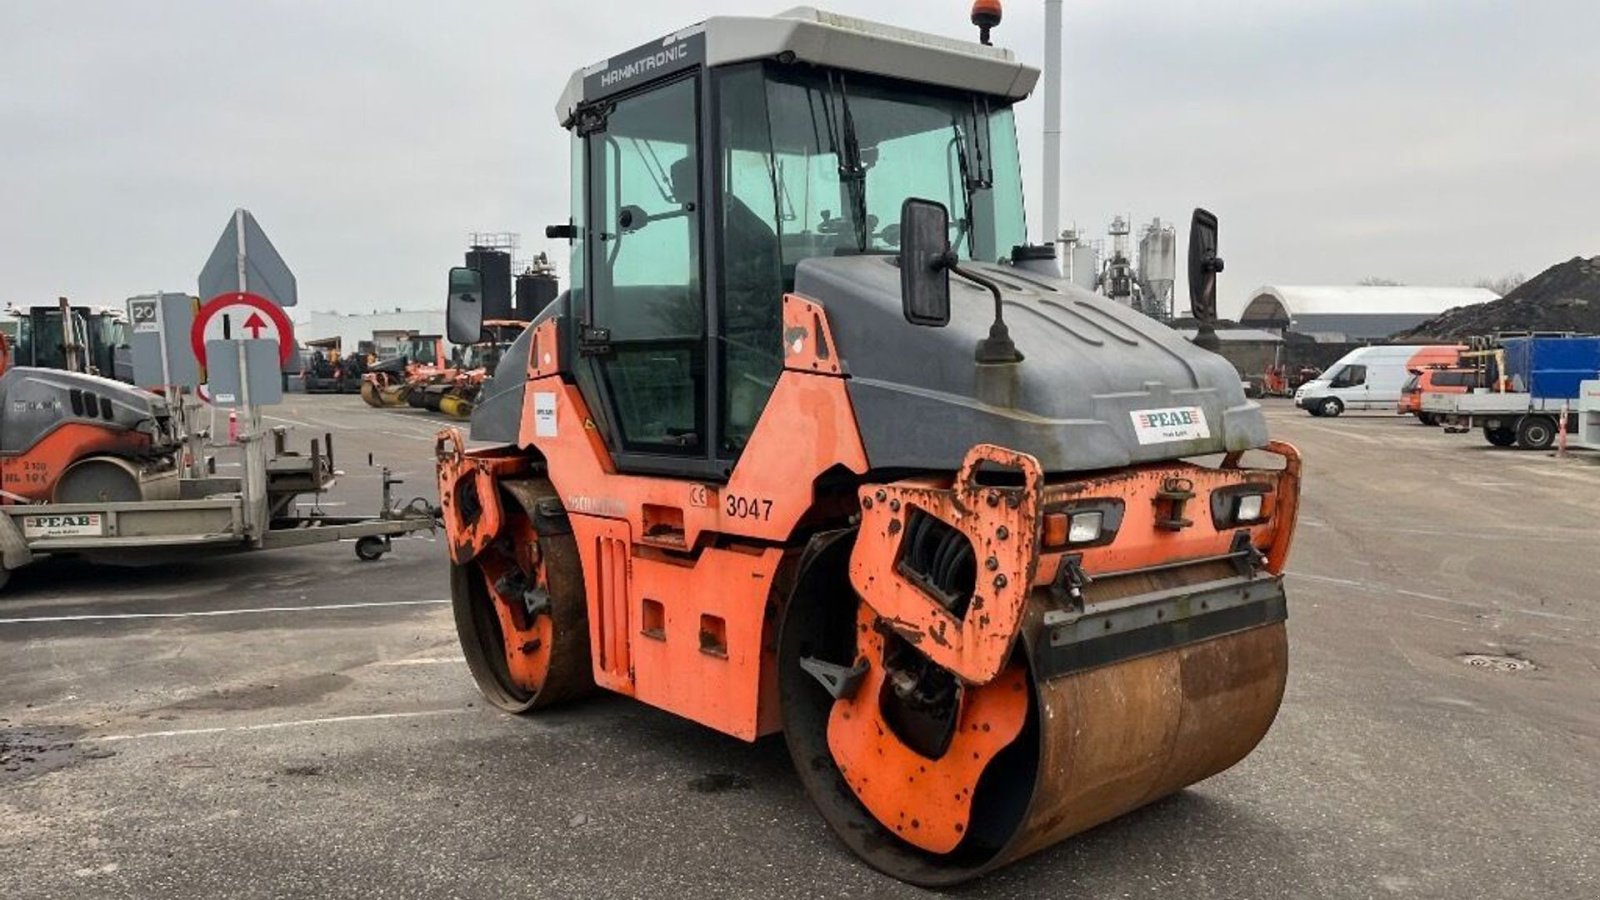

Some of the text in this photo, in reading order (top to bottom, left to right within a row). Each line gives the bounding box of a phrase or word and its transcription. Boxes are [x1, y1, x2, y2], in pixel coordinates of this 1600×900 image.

[601, 43, 688, 88] HAMMTRONIC
[134, 306, 154, 319] 20
[1147, 410, 1193, 428] PEAB
[726, 494, 773, 521] 3047
[35, 515, 90, 528] PEAB
